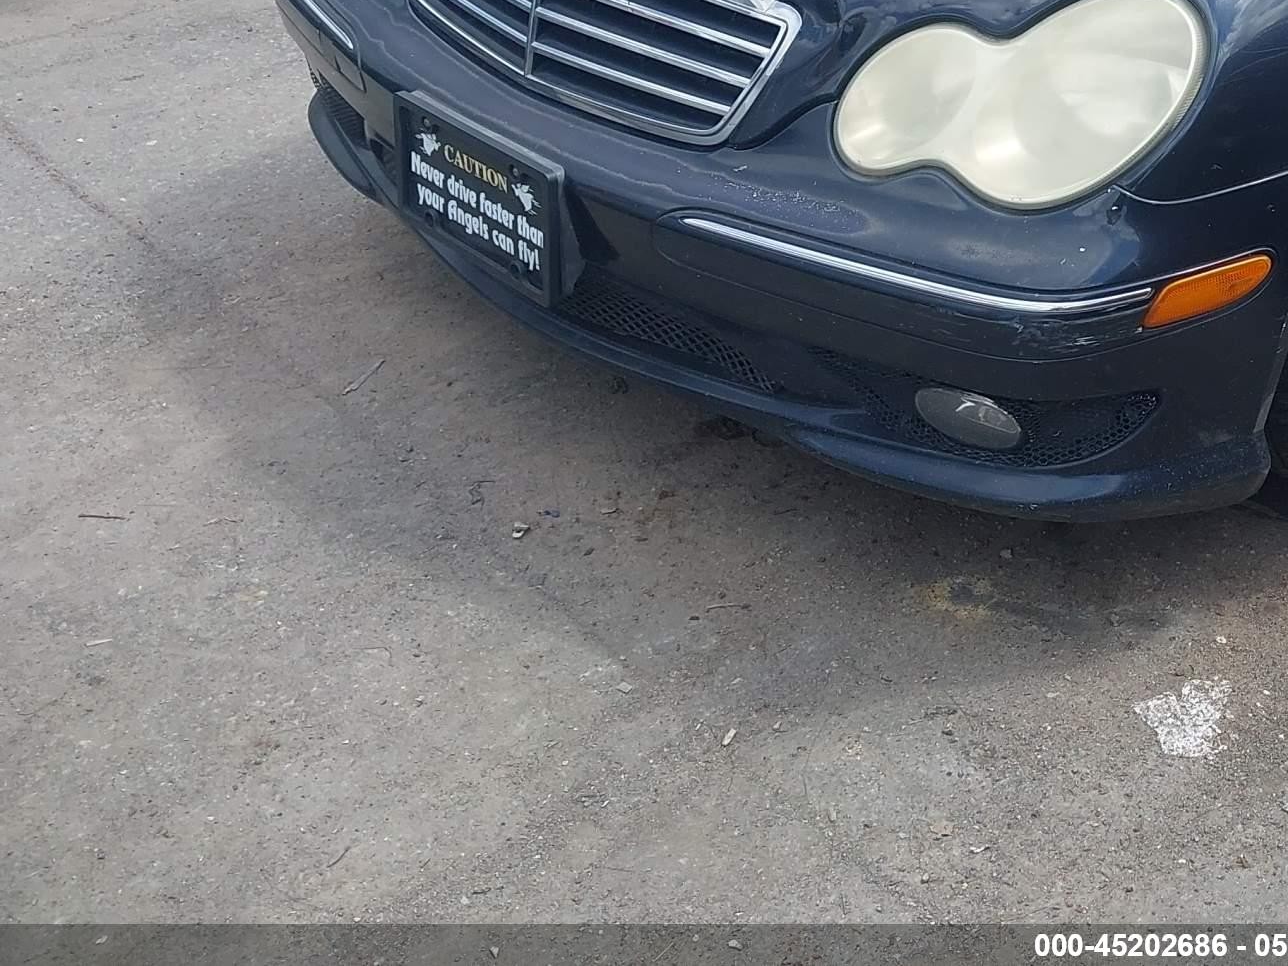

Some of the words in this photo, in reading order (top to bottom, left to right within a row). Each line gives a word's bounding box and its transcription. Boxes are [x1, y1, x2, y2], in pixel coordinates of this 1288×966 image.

[411, 151, 444, 188] Never
[447, 174, 477, 208] drive
[479, 192, 514, 230] faster
[517, 215, 544, 248] than
[444, 144, 508, 193] CAUTION
[417, 183, 445, 214] your
[447, 200, 489, 241] Angels
[492, 229, 515, 255] can
[518, 240, 540, 271] fly!
